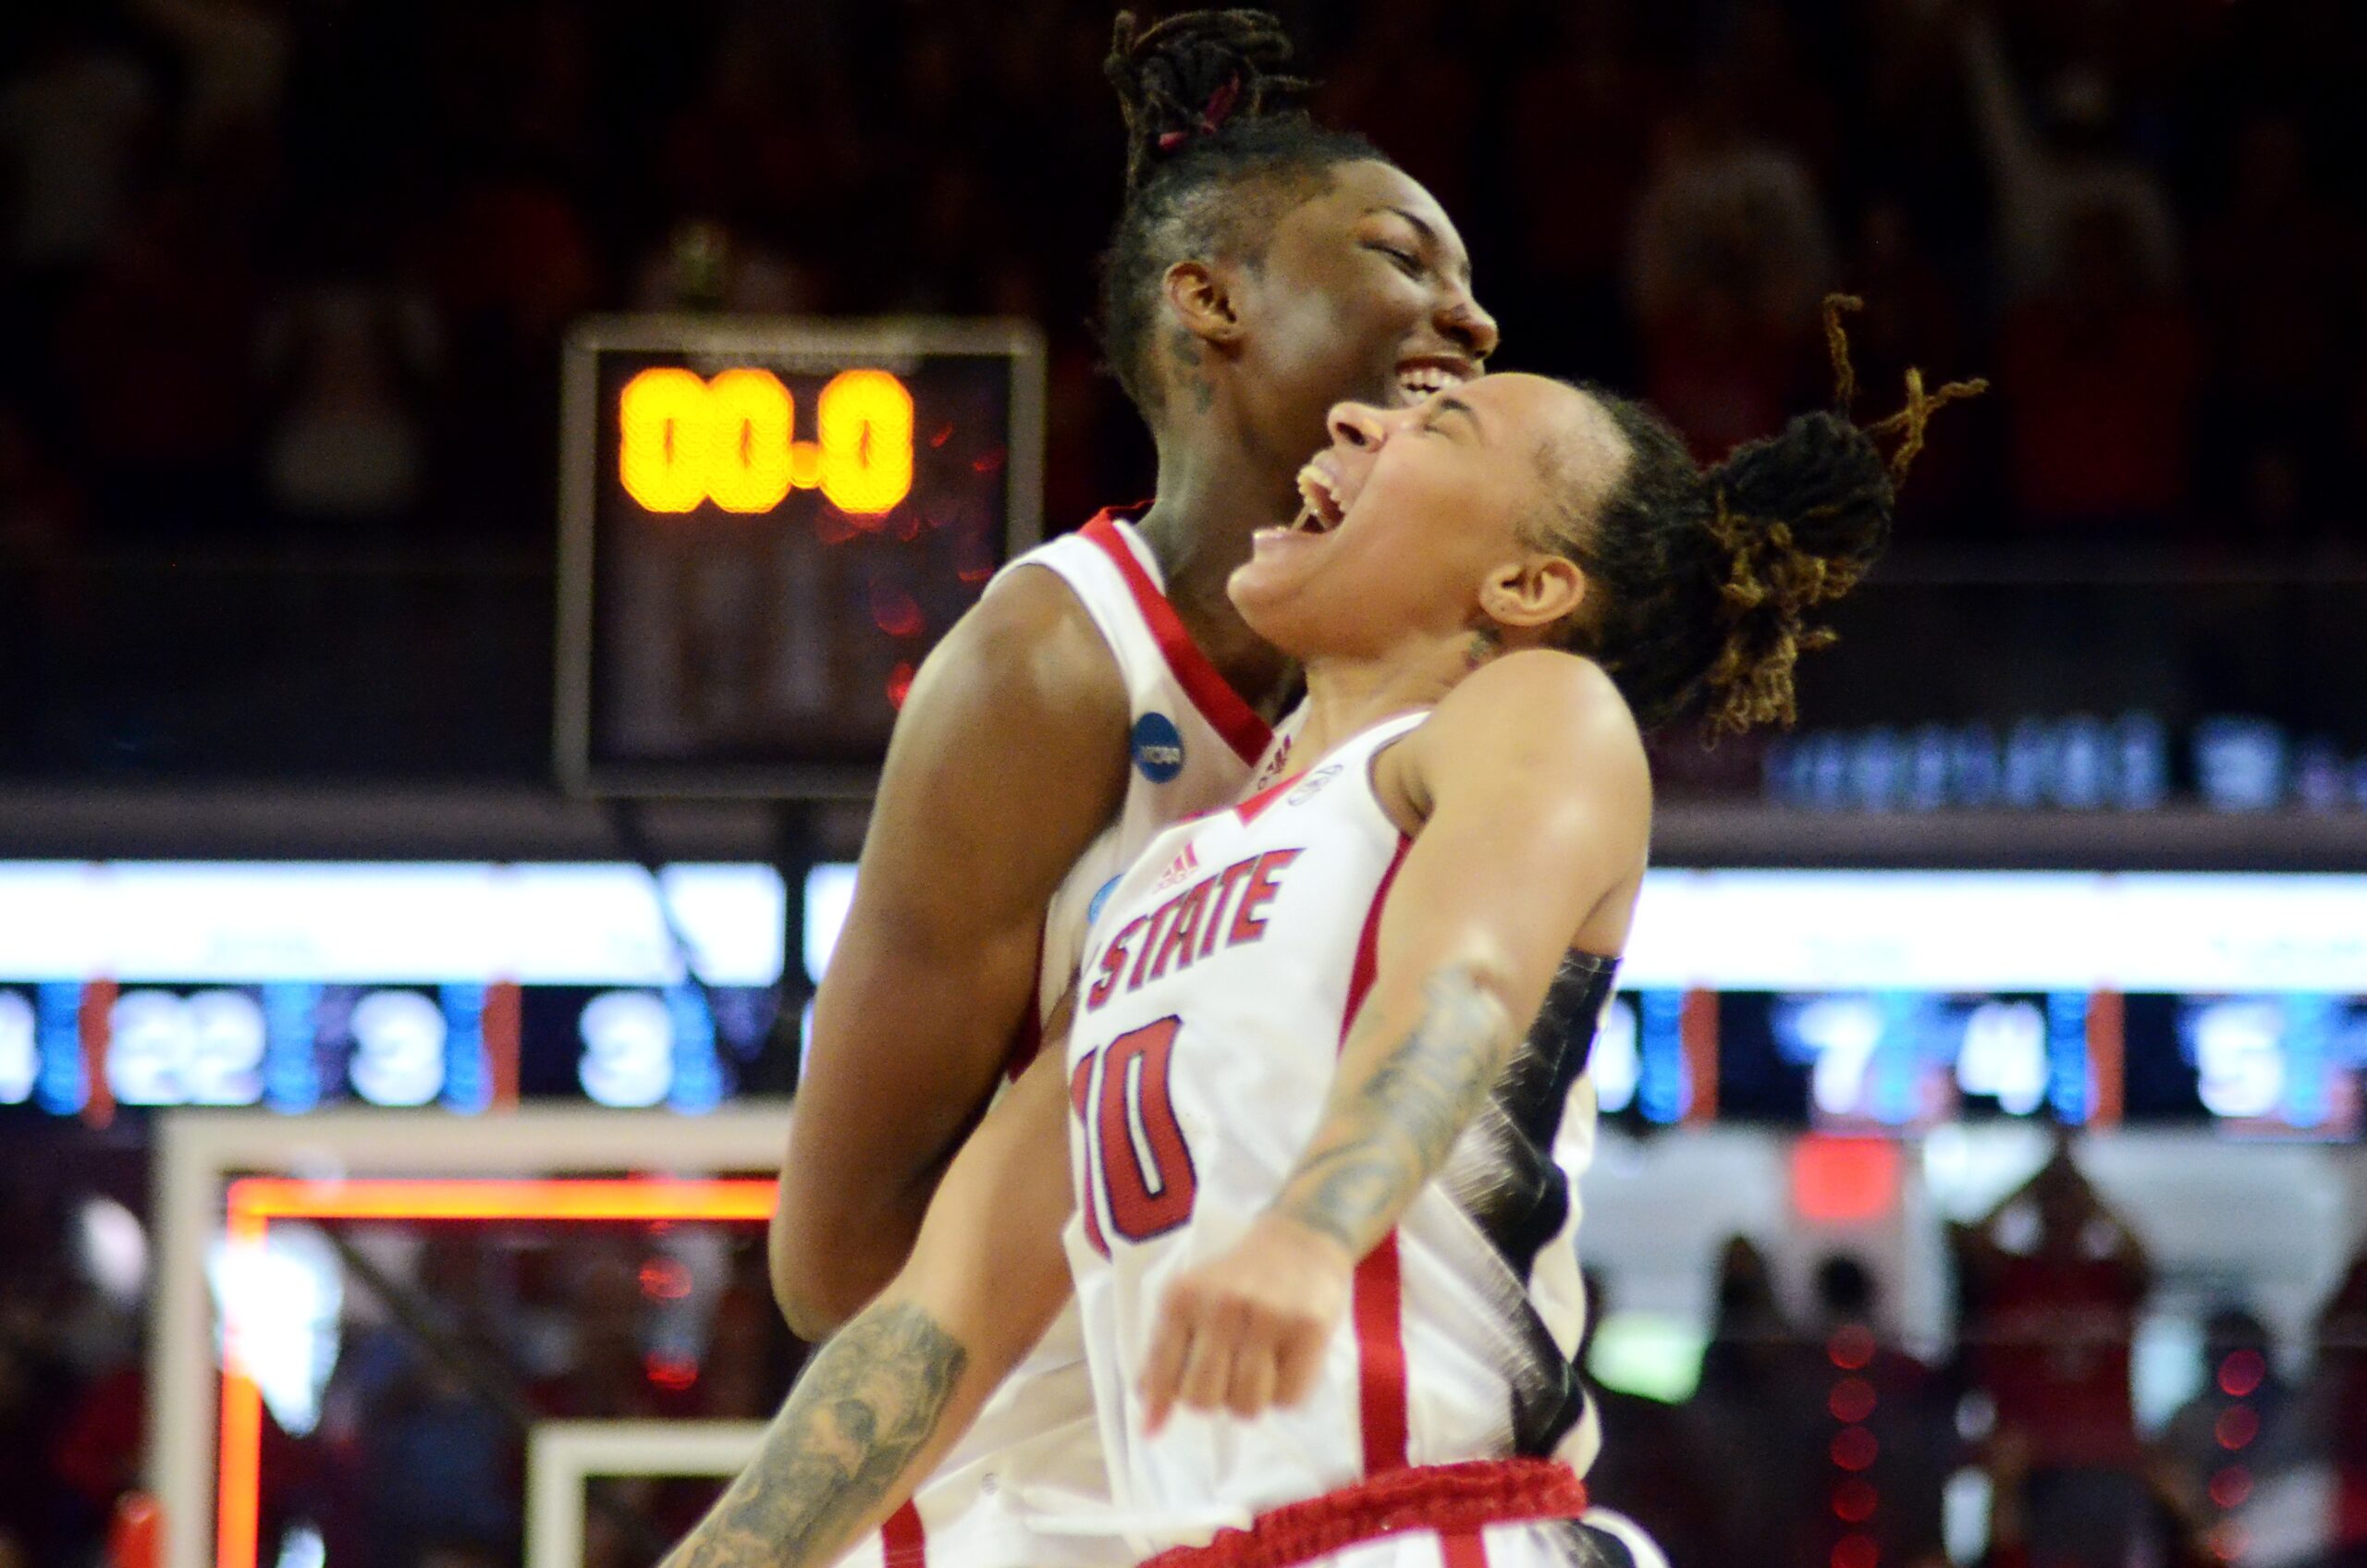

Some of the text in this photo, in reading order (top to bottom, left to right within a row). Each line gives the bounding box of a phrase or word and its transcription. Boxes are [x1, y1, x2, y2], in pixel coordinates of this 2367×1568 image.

[1085, 847, 1306, 1012] STATE
[350, 989, 447, 1107] 3
[579, 990, 672, 1108] 3
[1796, 997, 1883, 1114] 7
[2197, 1003, 2286, 1117] 5
